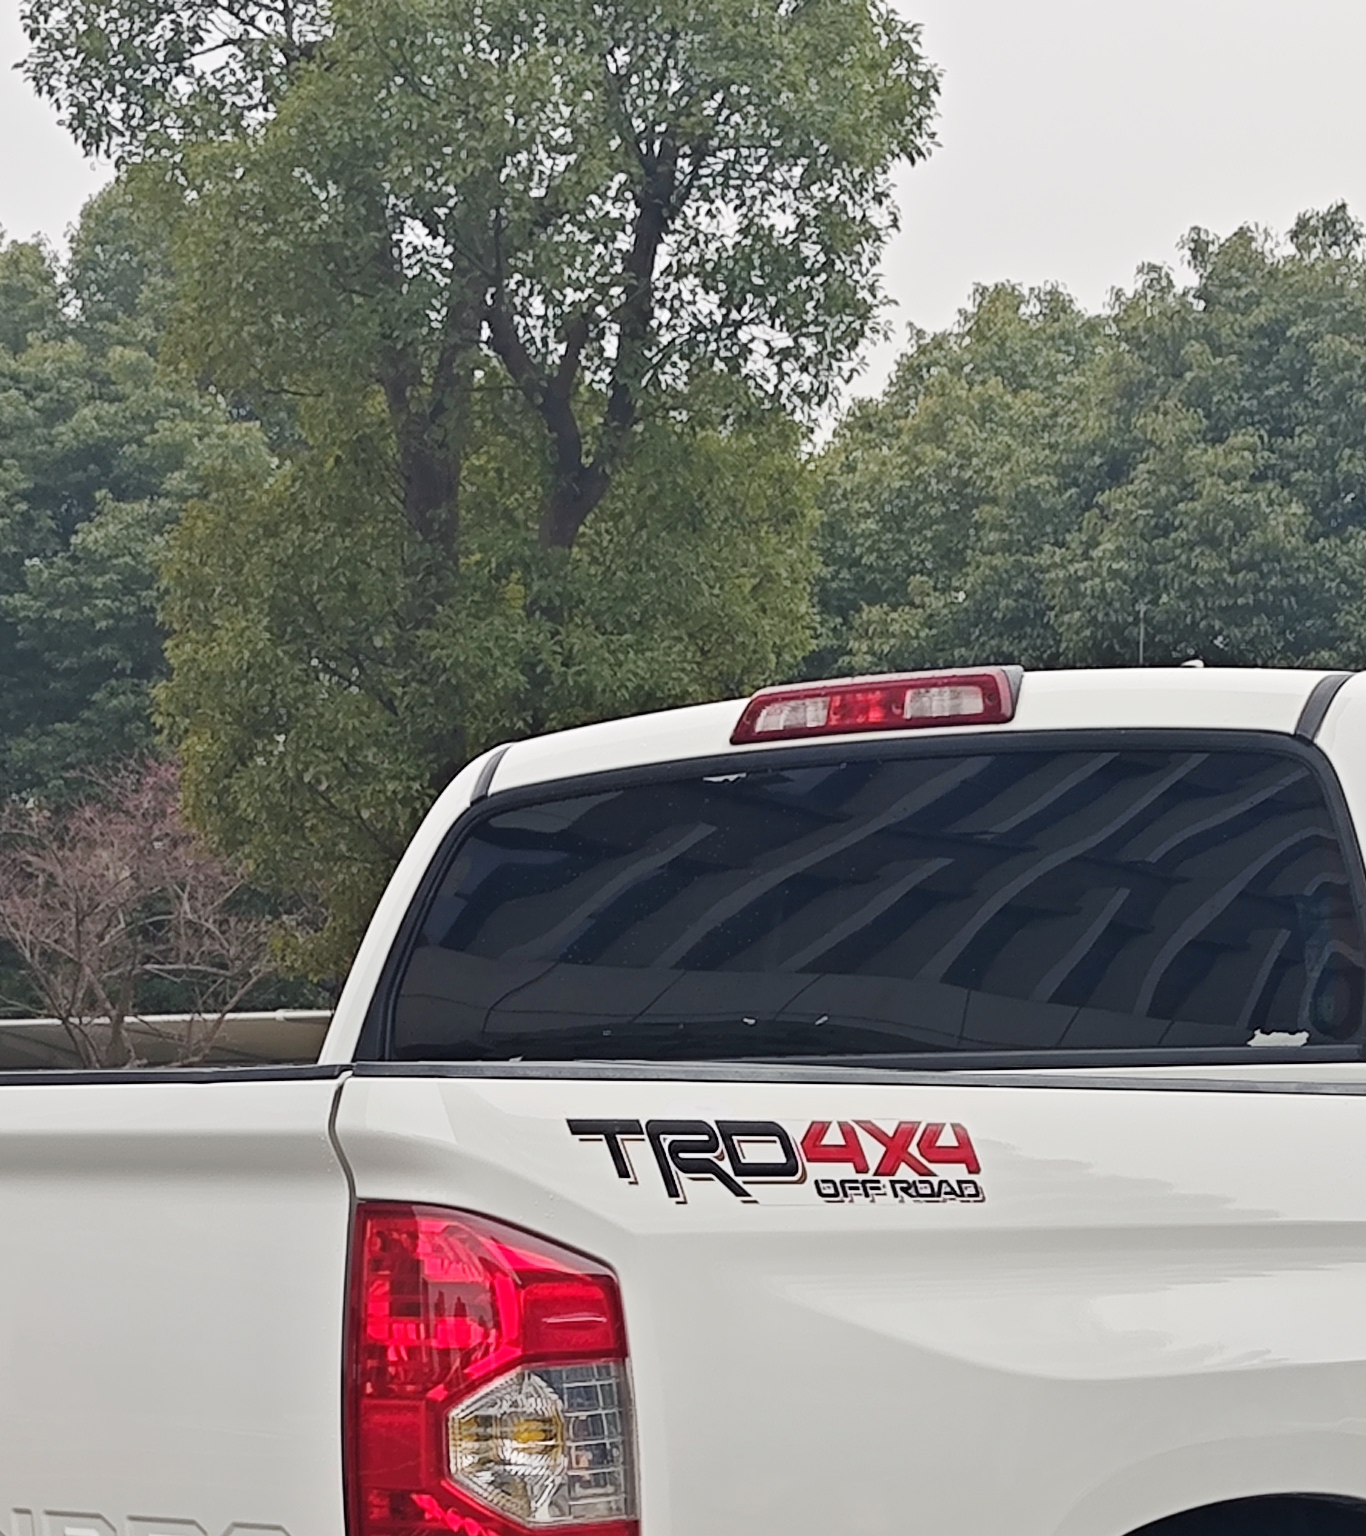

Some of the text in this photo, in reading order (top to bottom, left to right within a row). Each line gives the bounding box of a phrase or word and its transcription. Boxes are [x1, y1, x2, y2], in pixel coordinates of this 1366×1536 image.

[566, 1118, 981, 1205] TRD 4X4
[815, 1178, 986, 1203] OFF ROAD
